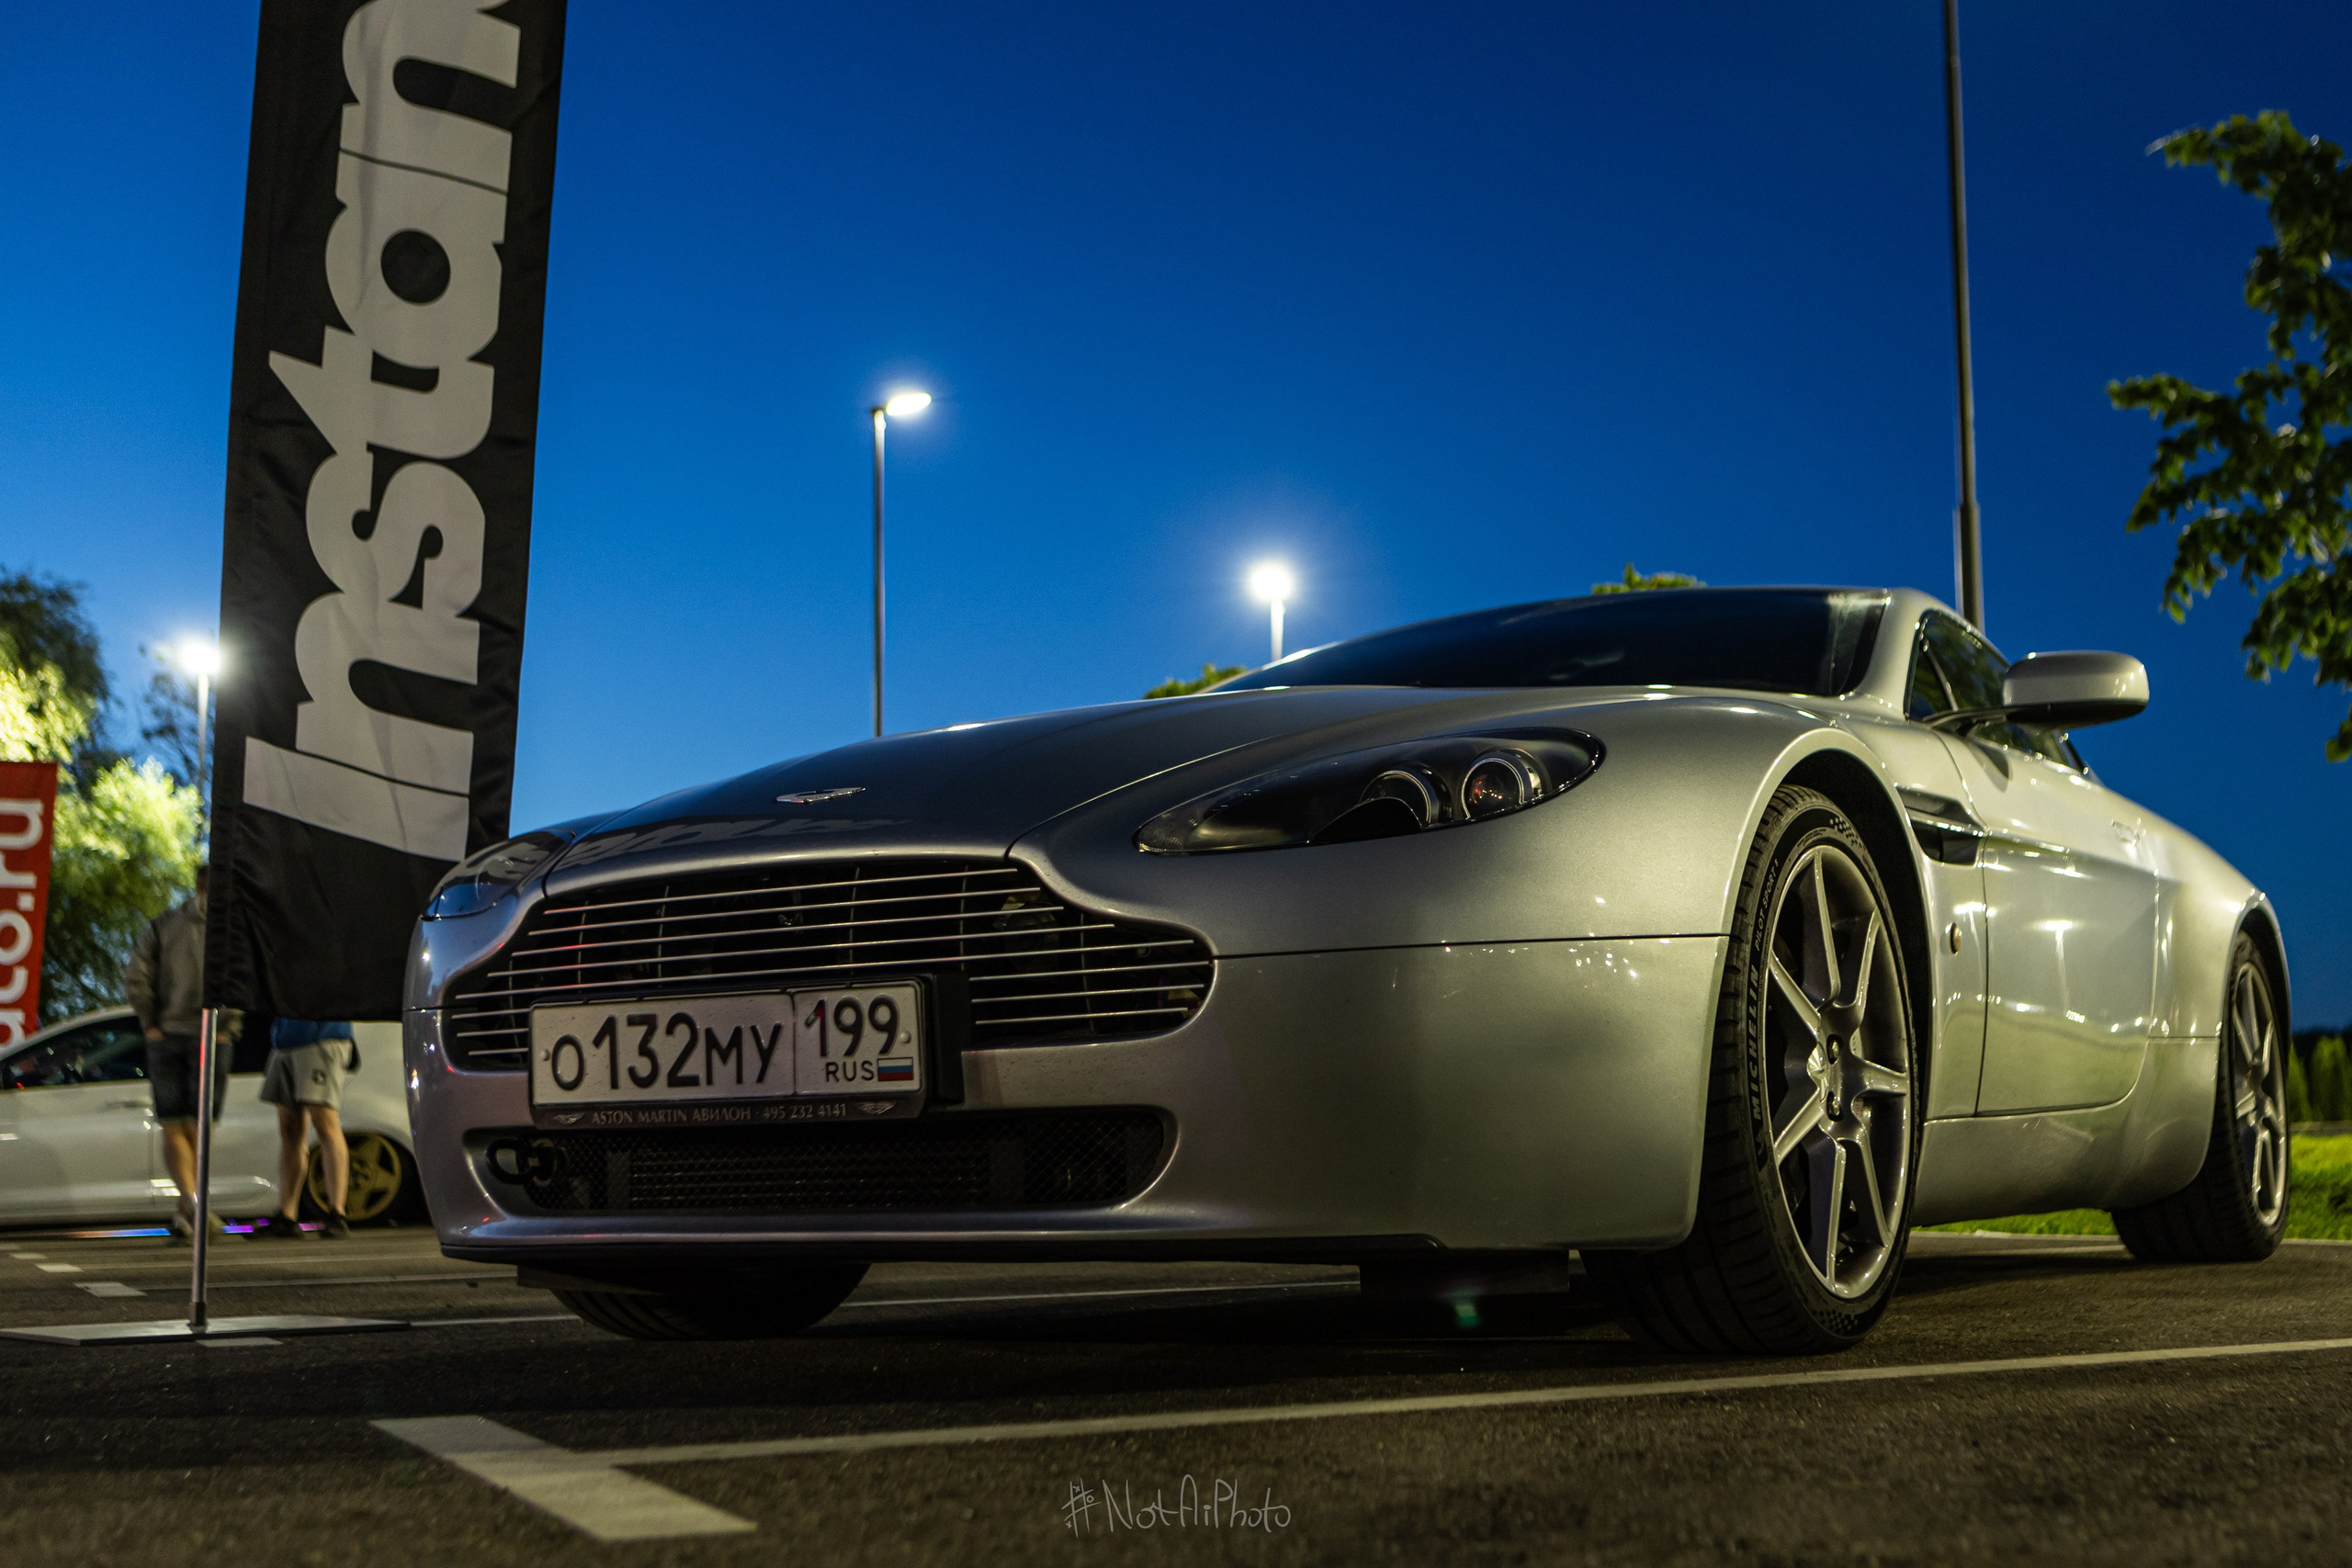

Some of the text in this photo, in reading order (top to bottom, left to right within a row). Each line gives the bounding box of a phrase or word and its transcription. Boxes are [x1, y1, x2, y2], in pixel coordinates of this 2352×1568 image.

[243, 0, 521, 861] Instan
[1755, 908, 1766, 952] PILOT
[1762, 866, 1777, 908] SPORT
[804, 994, 900, 1057] 199
[1748, 964, 1762, 1122] MICHELIN
[826, 1060, 876, 1082] RUS
[592, 1110, 633, 1125] ASTON
[638, 1108, 687, 1124] MARTIN
[763, 1105, 786, 1121] 495
[789, 1103, 814, 1119] 232
[818, 1102, 847, 1118] 4141
